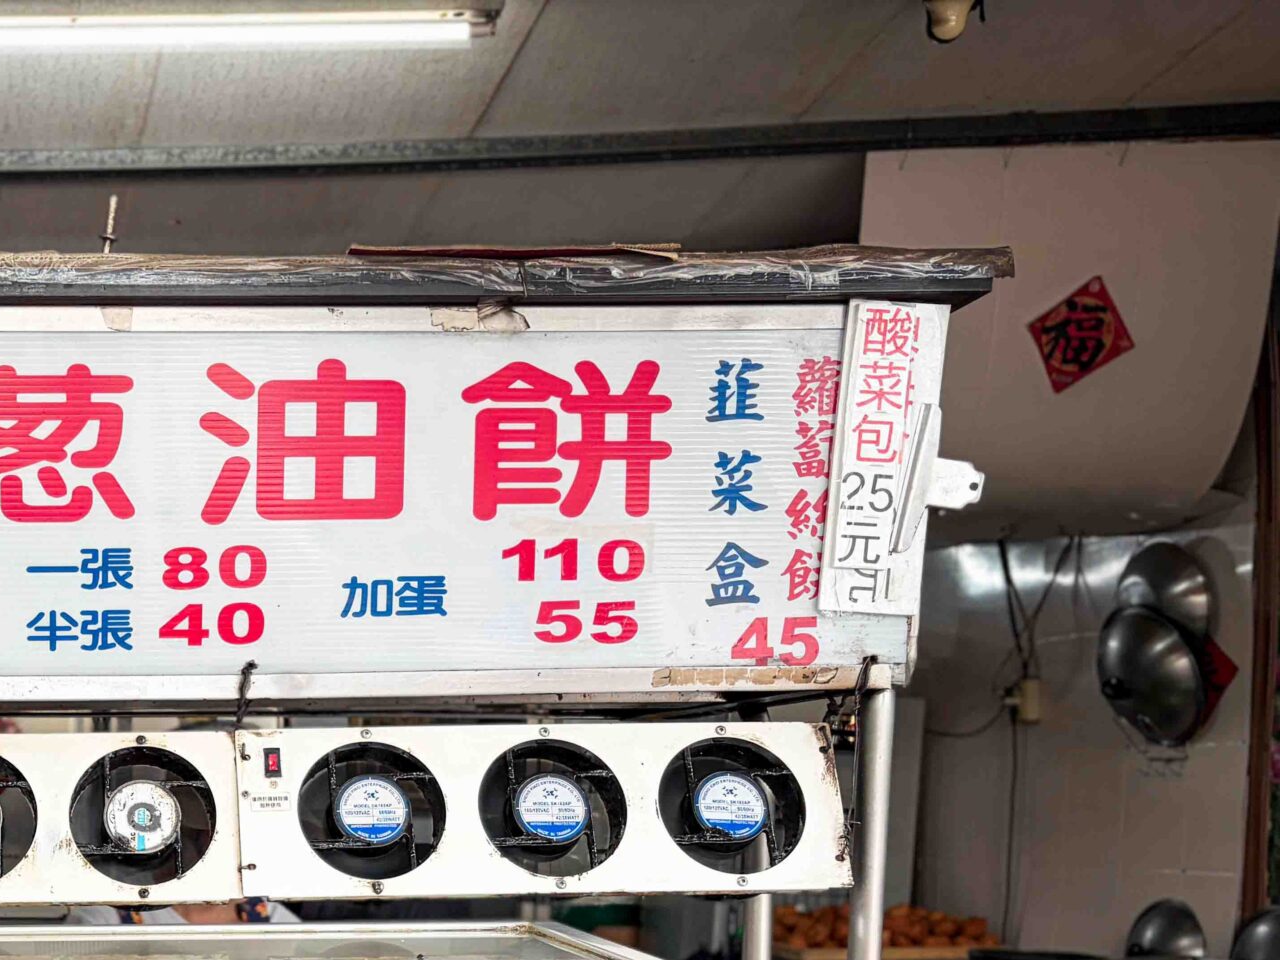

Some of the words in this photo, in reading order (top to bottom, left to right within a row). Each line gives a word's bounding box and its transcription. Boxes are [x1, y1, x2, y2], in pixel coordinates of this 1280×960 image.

[1042, 297, 1108, 370] 福
[26, 548, 133, 590] 一張
[162, 544, 267, 590] 80
[341, 575, 448, 617] 加蛋
[501, 538, 646, 582] 110
[26, 610, 133, 651] 半張
[158, 602, 266, 647] 40
[534, 600, 639, 644] 55
[731, 617, 820, 666] 45
